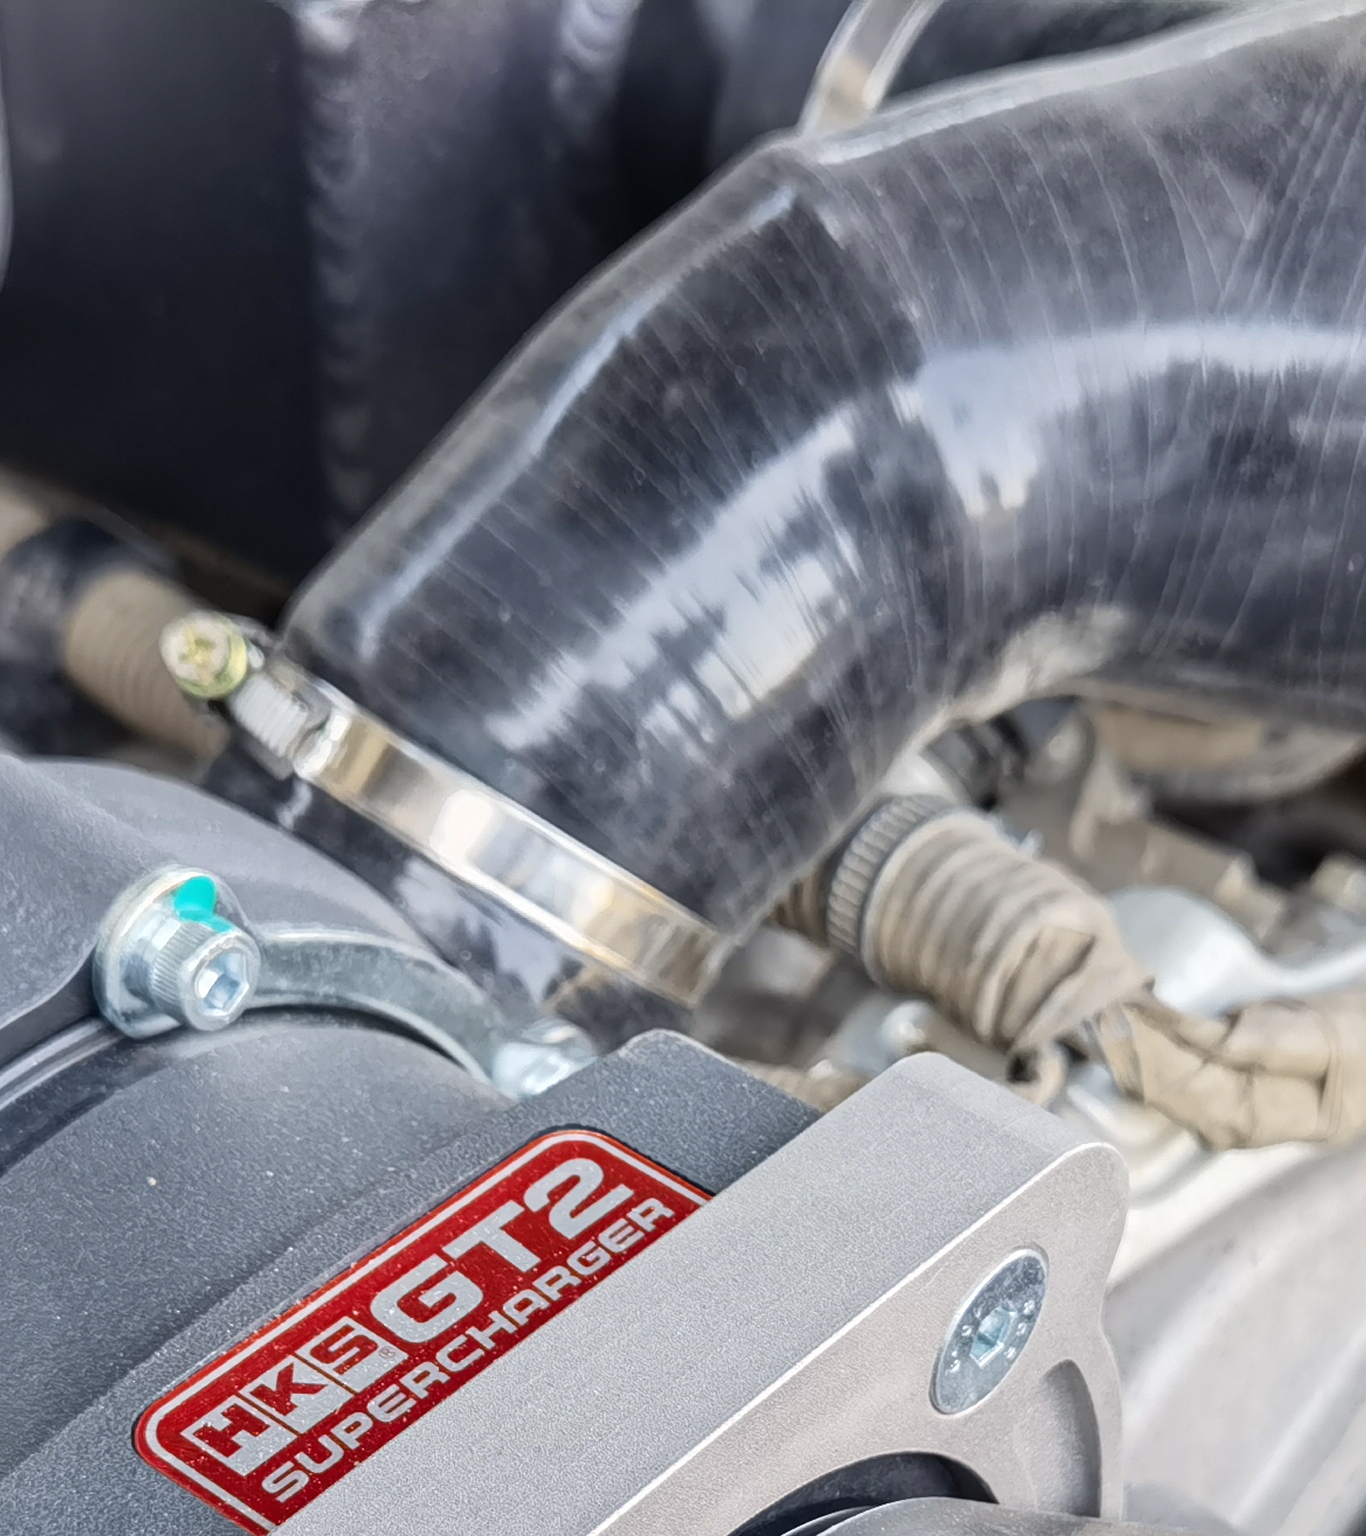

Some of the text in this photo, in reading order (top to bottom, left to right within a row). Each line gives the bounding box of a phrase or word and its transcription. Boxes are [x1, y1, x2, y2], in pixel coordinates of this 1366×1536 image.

[182, 1157, 635, 1477] HKS GT2
[262, 1197, 676, 1503] SUPERCHARGER
